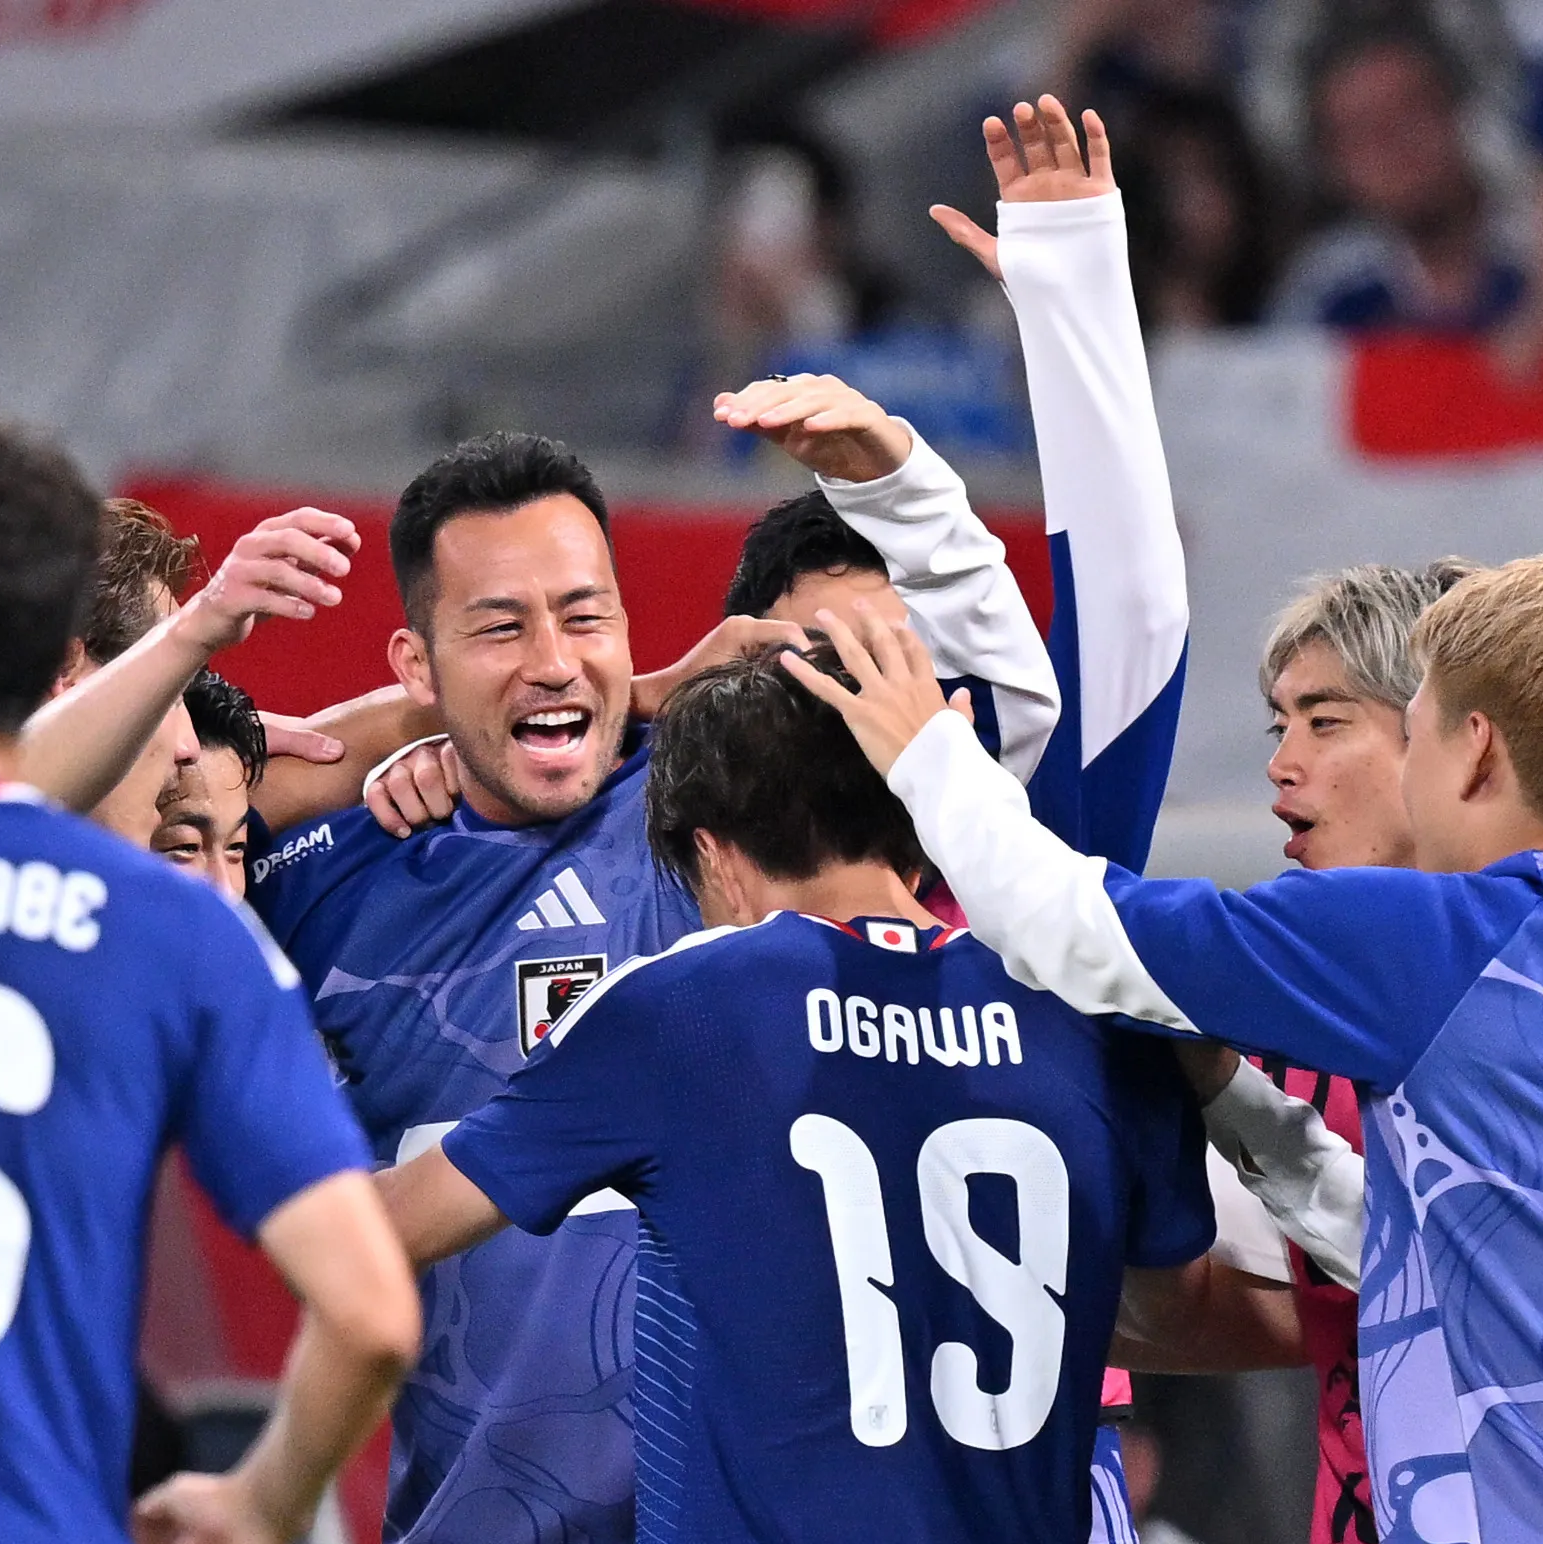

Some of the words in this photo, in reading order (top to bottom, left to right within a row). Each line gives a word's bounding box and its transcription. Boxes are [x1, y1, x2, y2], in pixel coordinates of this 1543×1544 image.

[253, 823, 334, 884] DREAM
[539, 961, 584, 974] JAPAN
[806, 987, 1023, 1067] OGAWA
[789, 1113, 1070, 1450] 19
